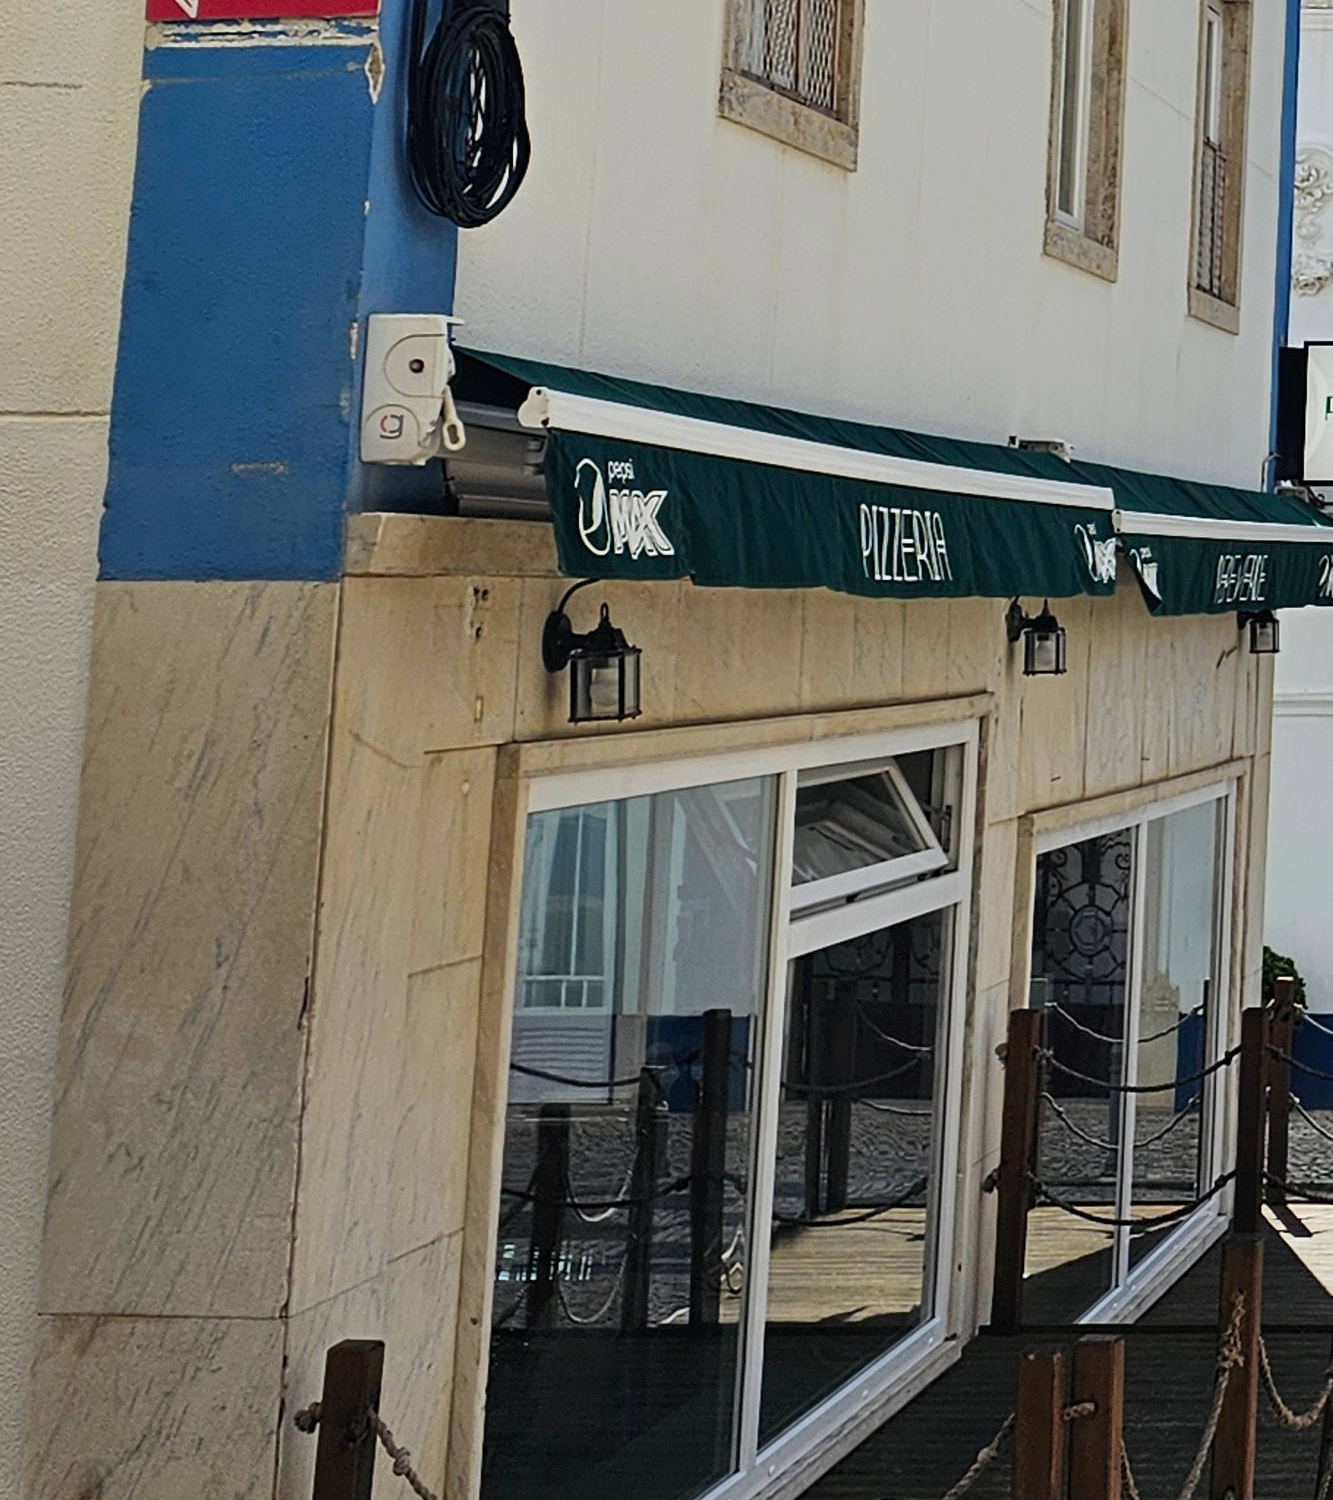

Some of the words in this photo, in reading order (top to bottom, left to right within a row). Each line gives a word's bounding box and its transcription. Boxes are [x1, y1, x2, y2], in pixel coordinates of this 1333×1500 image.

[607, 458, 635, 484] pepsi
[608, 488, 675, 560] MAX
[859, 503, 953, 582] PIZZERIA
